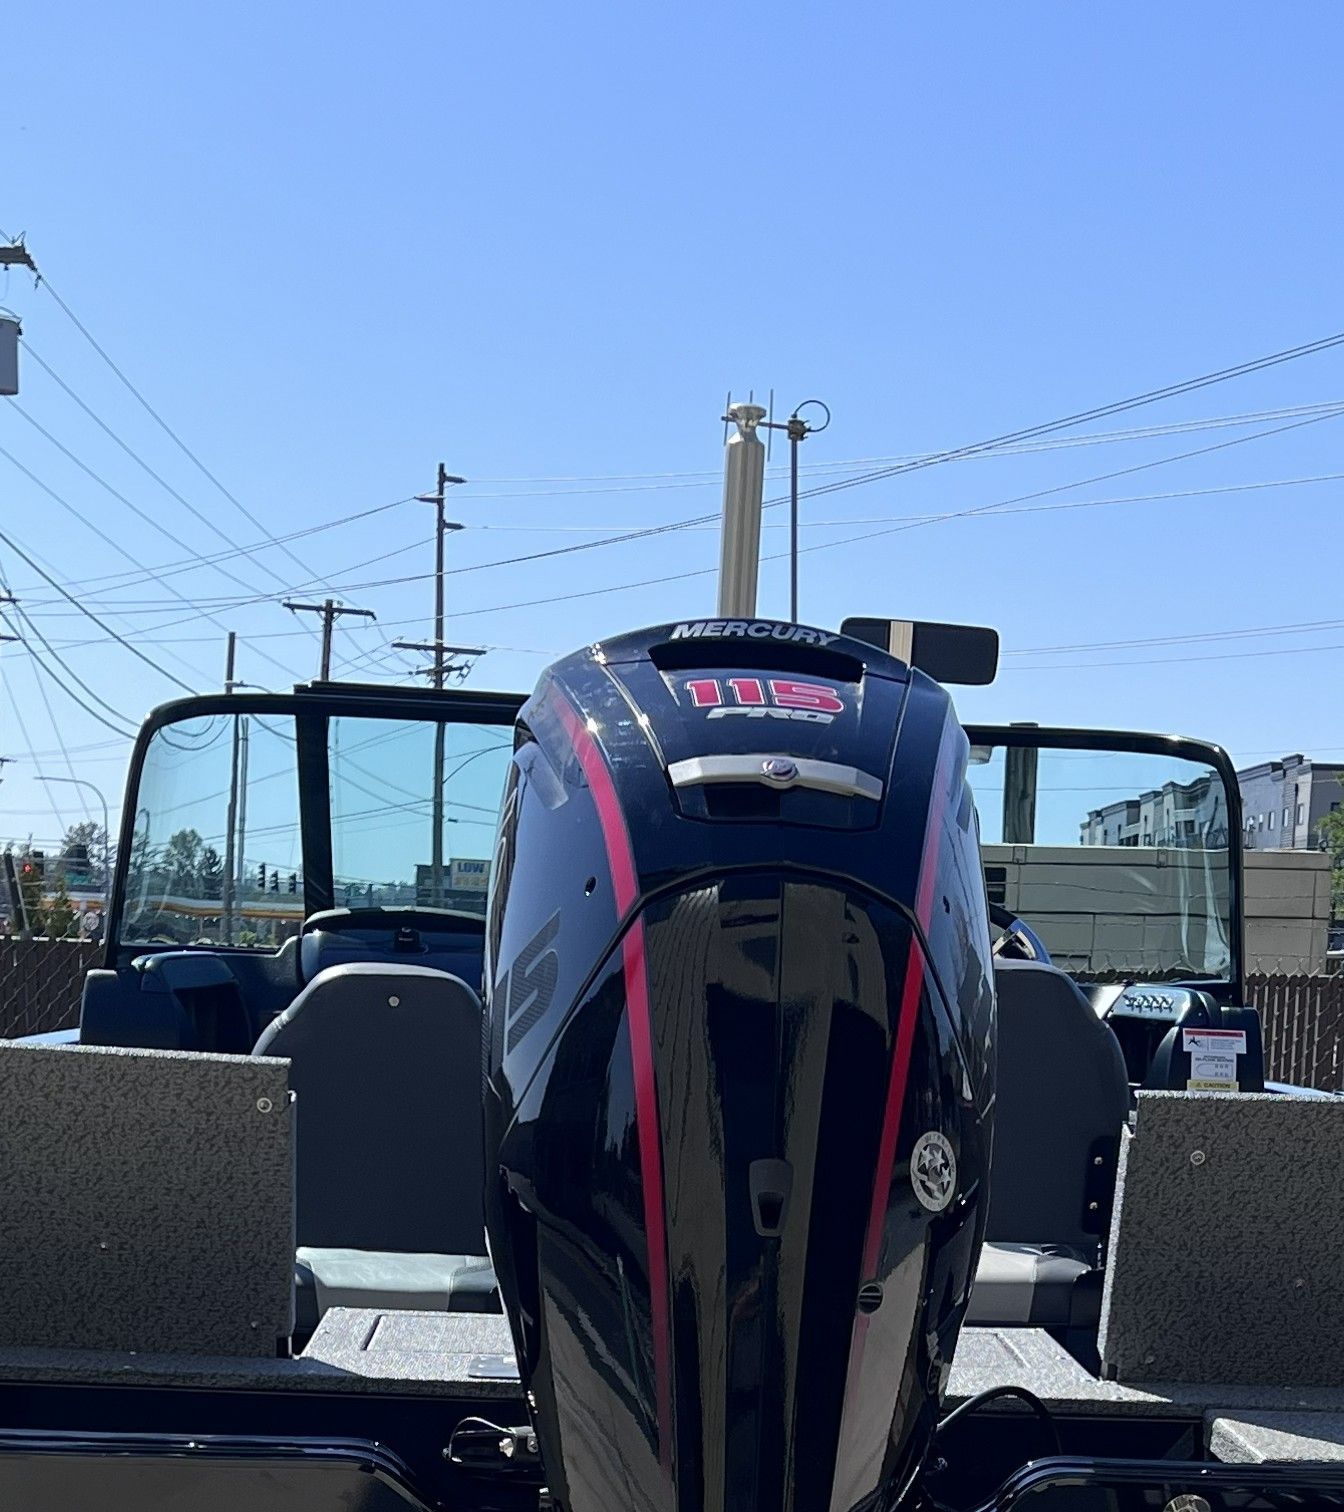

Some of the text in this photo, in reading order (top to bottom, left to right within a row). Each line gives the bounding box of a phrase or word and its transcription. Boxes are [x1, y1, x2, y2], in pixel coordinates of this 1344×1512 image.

[671, 621, 840, 646] MERCURY
[684, 678, 845, 713] 115
[707, 706, 835, 724] PRO
